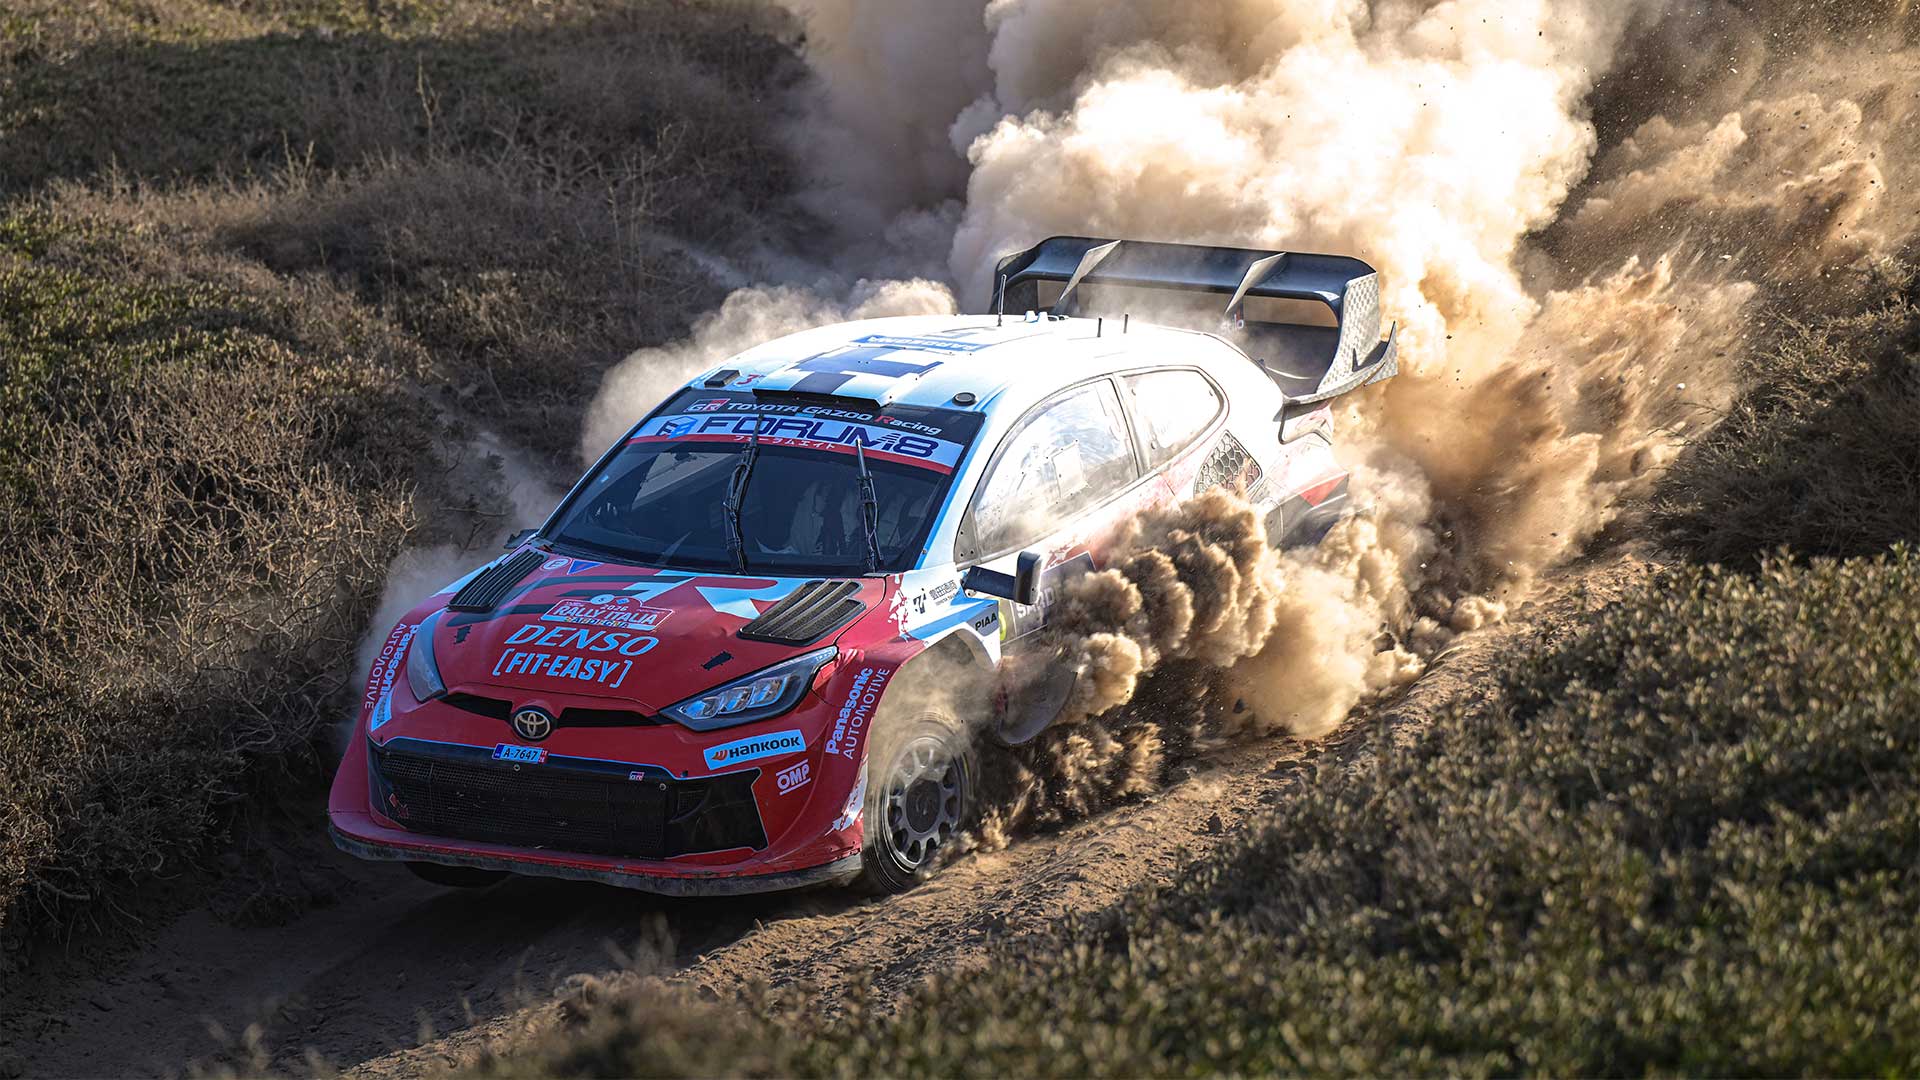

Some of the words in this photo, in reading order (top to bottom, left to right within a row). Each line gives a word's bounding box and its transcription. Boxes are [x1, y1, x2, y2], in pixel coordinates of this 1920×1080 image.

[728, 402, 799, 414] TOYOTA
[802, 406, 873, 422] GAZOO
[874, 415, 943, 435] Racing
[697, 416, 939, 458] FORUM8
[733, 435, 836, 449] フーラムエイト
[553, 605, 605, 618] RALLY
[604, 610, 658, 625] ITALIA
[975, 612, 998, 631] PIAA
[504, 625, 660, 656] DENSO
[379, 624, 420, 696] Panasoni
[825, 667, 873, 755] Panasonic
[843, 668, 890, 760] AUTOMOTIVE
[503, 748, 538, 760] A-7647
[776, 765, 810, 791] OMP
